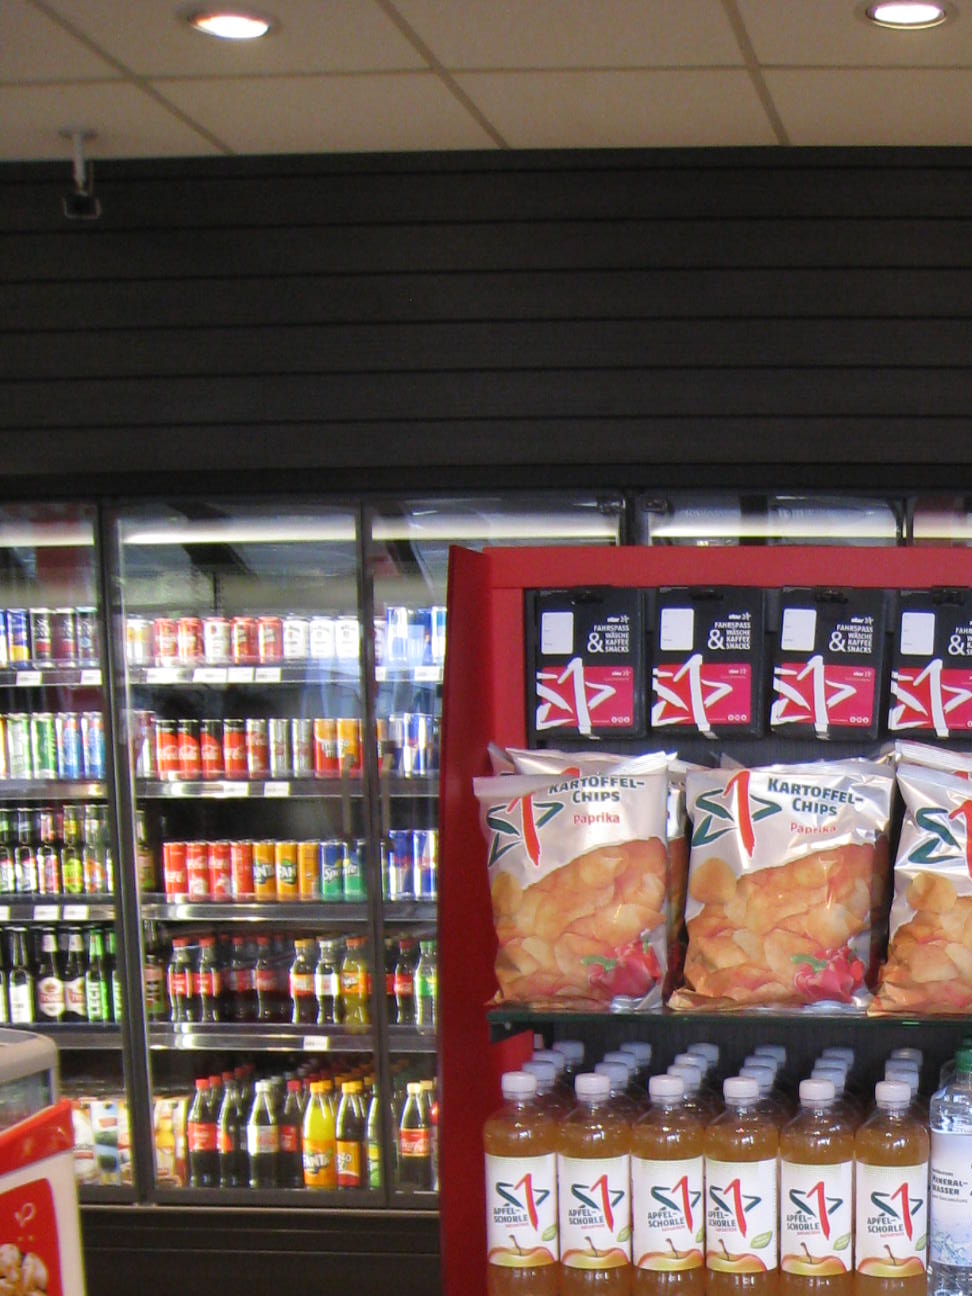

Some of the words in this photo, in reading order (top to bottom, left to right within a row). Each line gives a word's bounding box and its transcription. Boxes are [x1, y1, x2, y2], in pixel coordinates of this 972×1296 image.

[714, 621, 751, 629] FAHRSPASS
[836, 624, 873, 632] FAHRSPASS
[587, 633, 604, 652] &
[708, 630, 725, 649] &
[829, 632, 845, 652] &
[948, 635, 965, 655] &
[548, 775, 645, 794] KARTOFFEL-
[572, 788, 621, 803] CHIPS
[767, 777, 864, 805] KARTOFFEL-
[791, 797, 838, 817] CHIPS
[789, 821, 837, 835] Paprika
[493, 1207, 521, 1217] APFEL-
[568, 1208, 598, 1218] APFEL-
[648, 1211, 678, 1220] APFEL-
[493, 1215, 529, 1224] SCHORLE
[568, 1216, 604, 1226] SCHORLE
[647, 1218, 686, 1229] SCHORLE
[866, 1216, 897, 1225] APFEL-
[867, 1224, 904, 1234] SCHORLE
